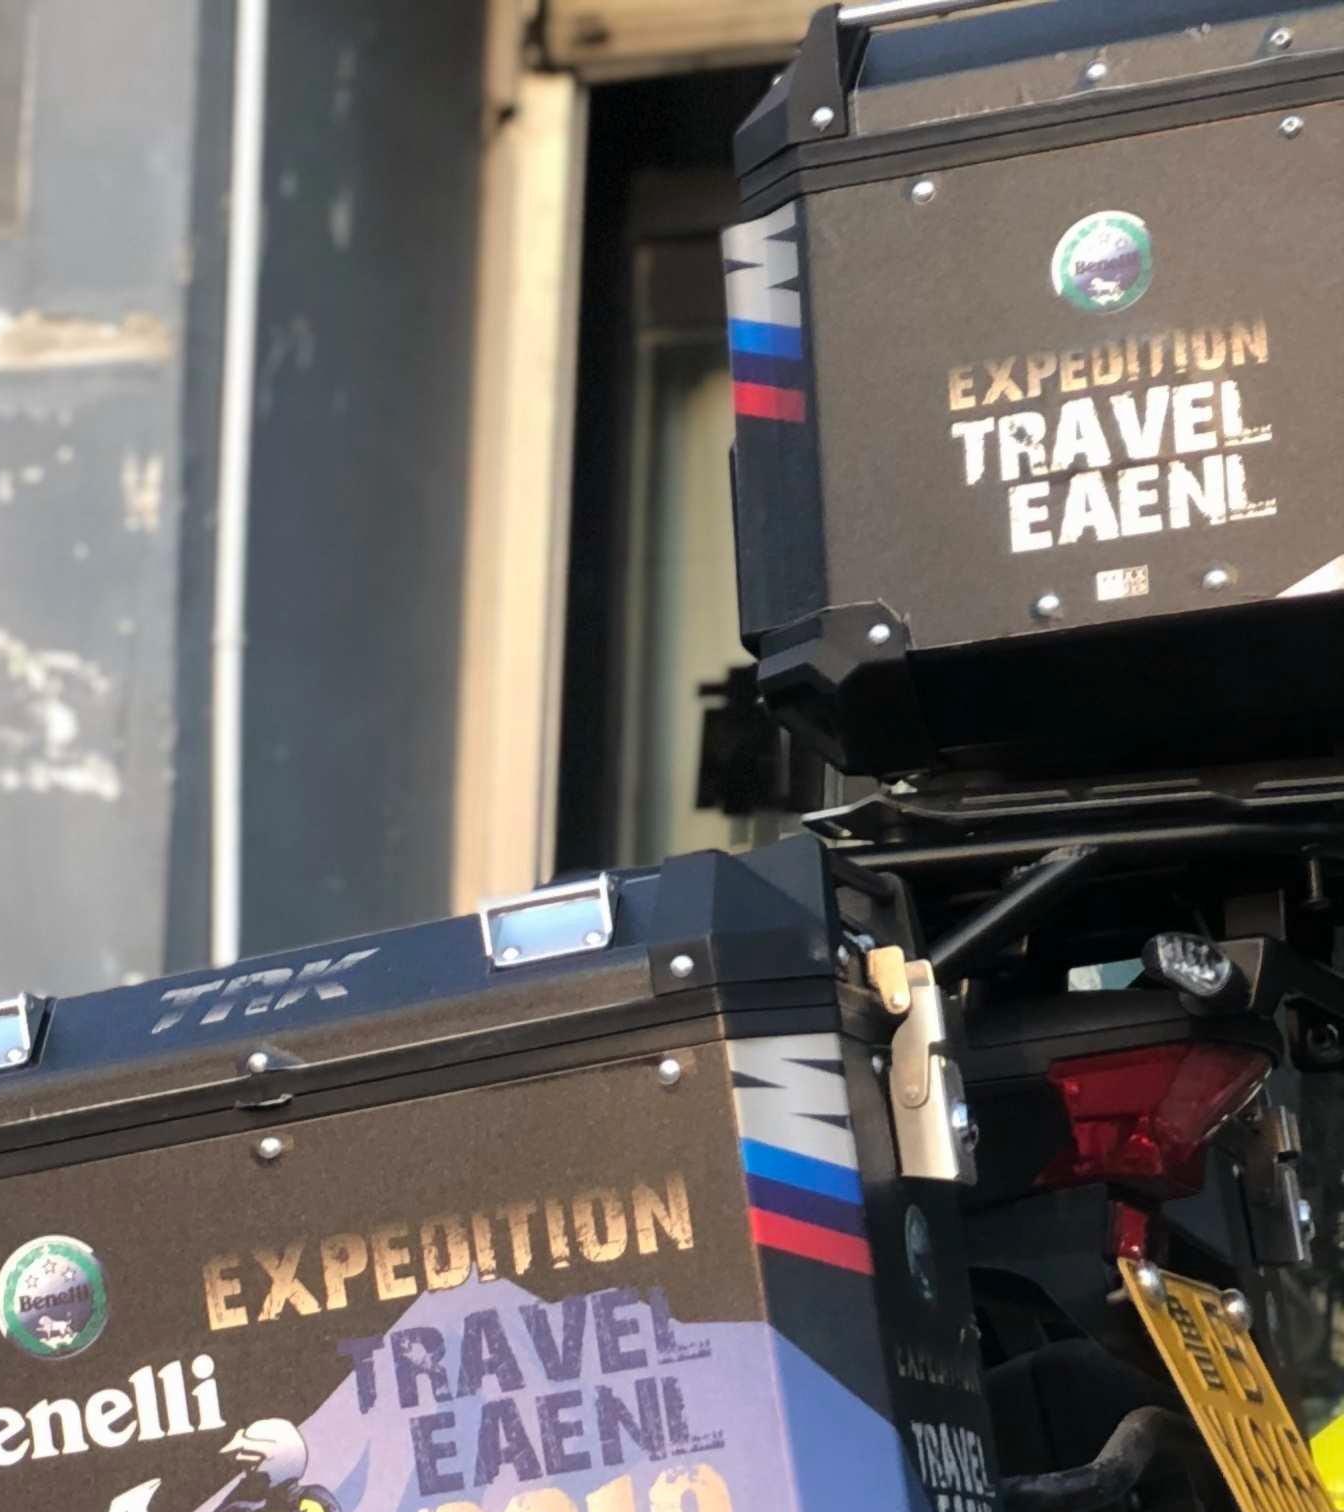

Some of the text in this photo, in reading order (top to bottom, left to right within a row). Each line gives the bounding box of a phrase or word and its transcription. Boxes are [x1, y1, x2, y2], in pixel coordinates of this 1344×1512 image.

[947, 315, 1270, 411] EXPEDITION
[949, 379, 1272, 486] TRAVEL
[1009, 453, 1278, 553] EAENL
[151, 947, 381, 1034] TRK
[18, 1283, 92, 1314] Benelli
[201, 1172, 695, 1331] EXPEDITION
[336, 1286, 711, 1415] TRAVEL
[410, 1375, 725, 1497] EAENL
[910, 1421, 997, 1498] TRAVEL
